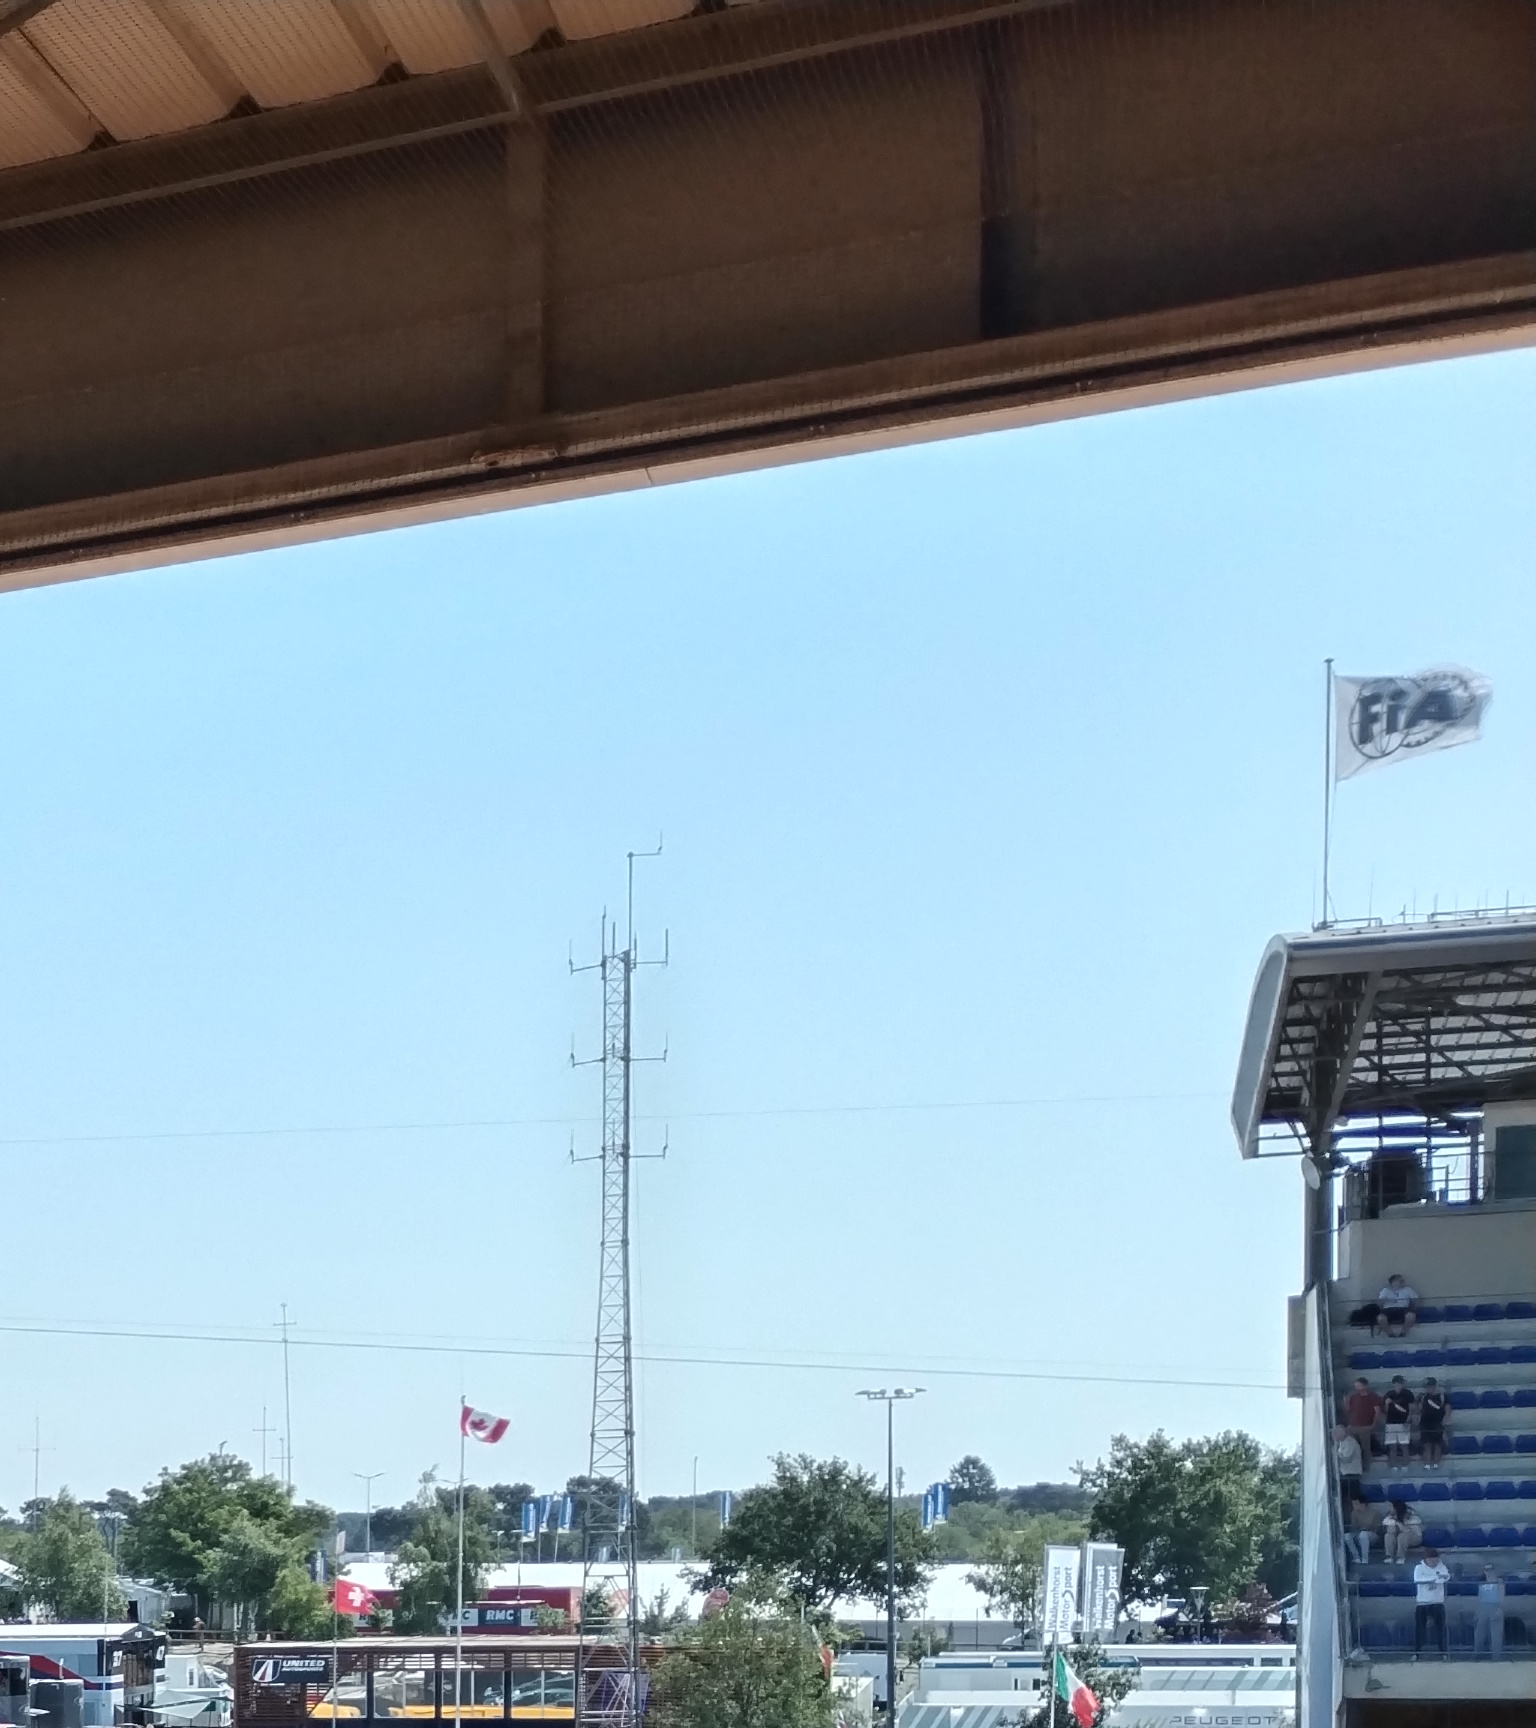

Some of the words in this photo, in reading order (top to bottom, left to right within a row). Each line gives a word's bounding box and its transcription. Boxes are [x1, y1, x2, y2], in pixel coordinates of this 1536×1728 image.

[485, 1610, 515, 1621] RMC
[282, 1659, 326, 1667] UNITED
[1168, 1715, 1278, 1727] PEUGEOT
